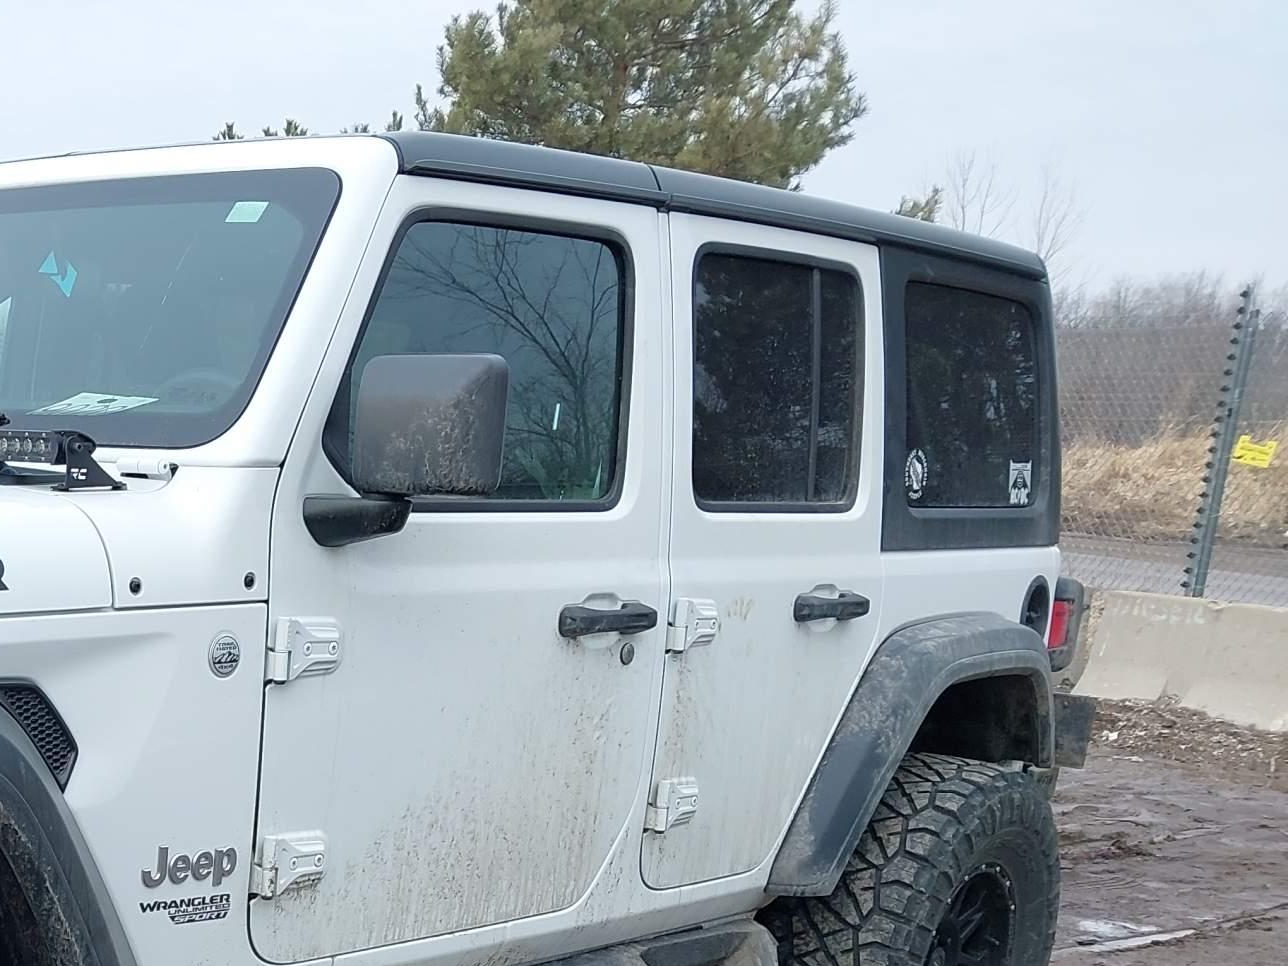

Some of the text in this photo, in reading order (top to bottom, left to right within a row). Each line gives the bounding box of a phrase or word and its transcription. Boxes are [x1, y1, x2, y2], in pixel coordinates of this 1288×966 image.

[141, 846, 237, 888] Jeep
[139, 893, 231, 913] WRANGLER
[168, 902, 231, 916] UNLIMITED
[173, 911, 228, 923] SPORT
